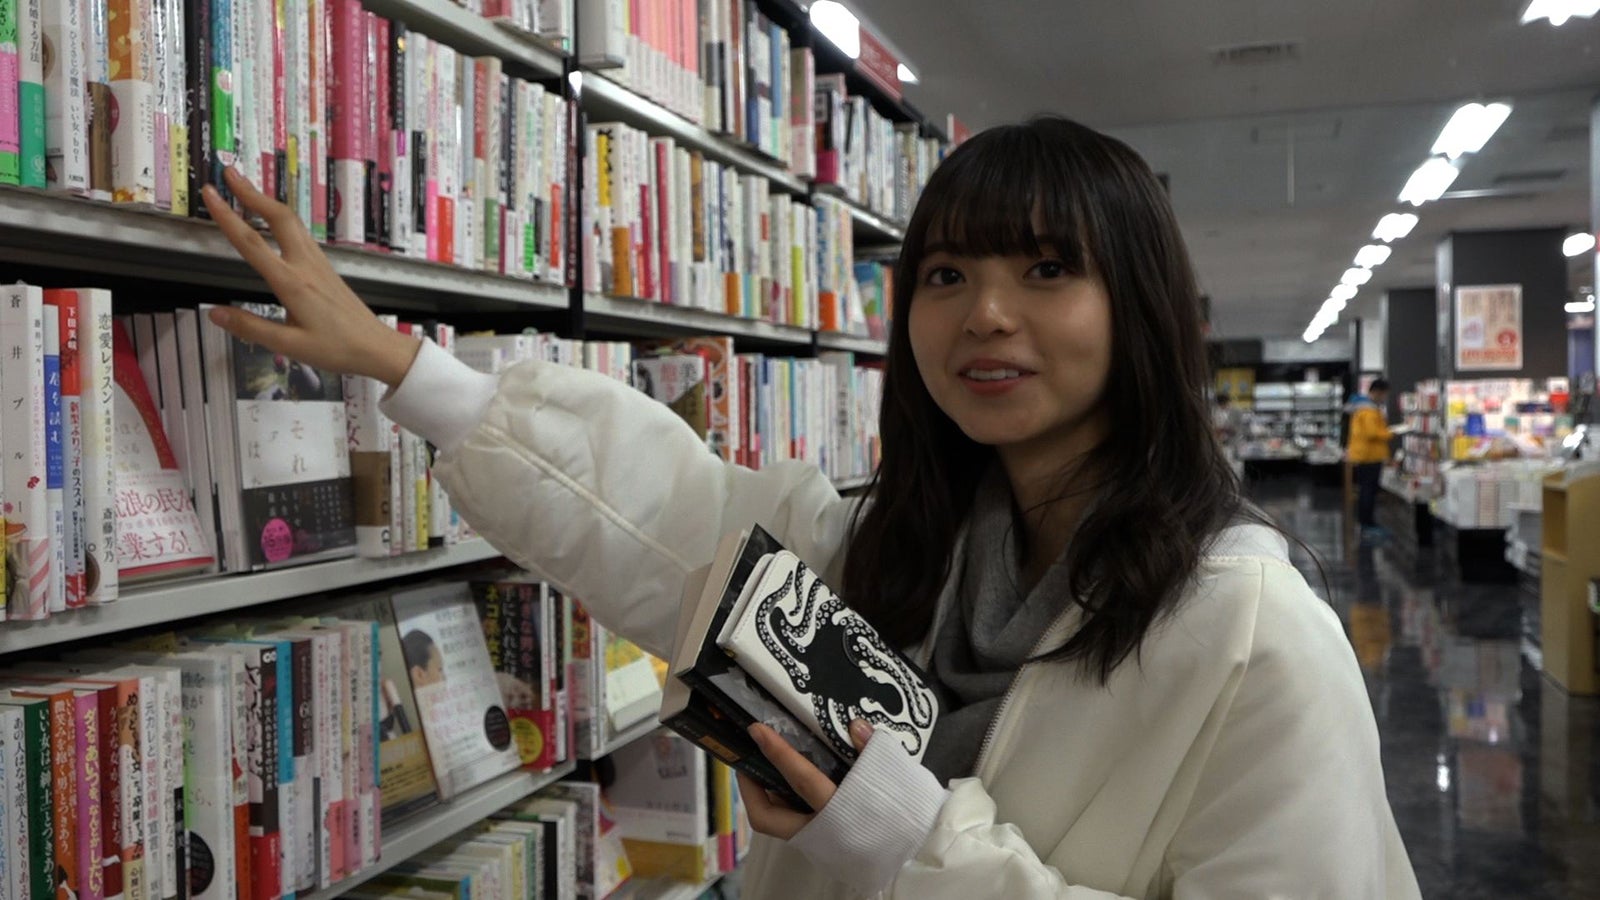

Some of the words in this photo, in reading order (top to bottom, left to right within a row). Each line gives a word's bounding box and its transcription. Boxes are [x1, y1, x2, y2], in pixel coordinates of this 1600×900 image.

[98, 312, 113, 404] 恋愛レッスン
[70, 401, 82, 508] 新型ぶりっ子のススメ
[13, 717, 30, 900] あの人はなぜ恋人とめぐりあえ
